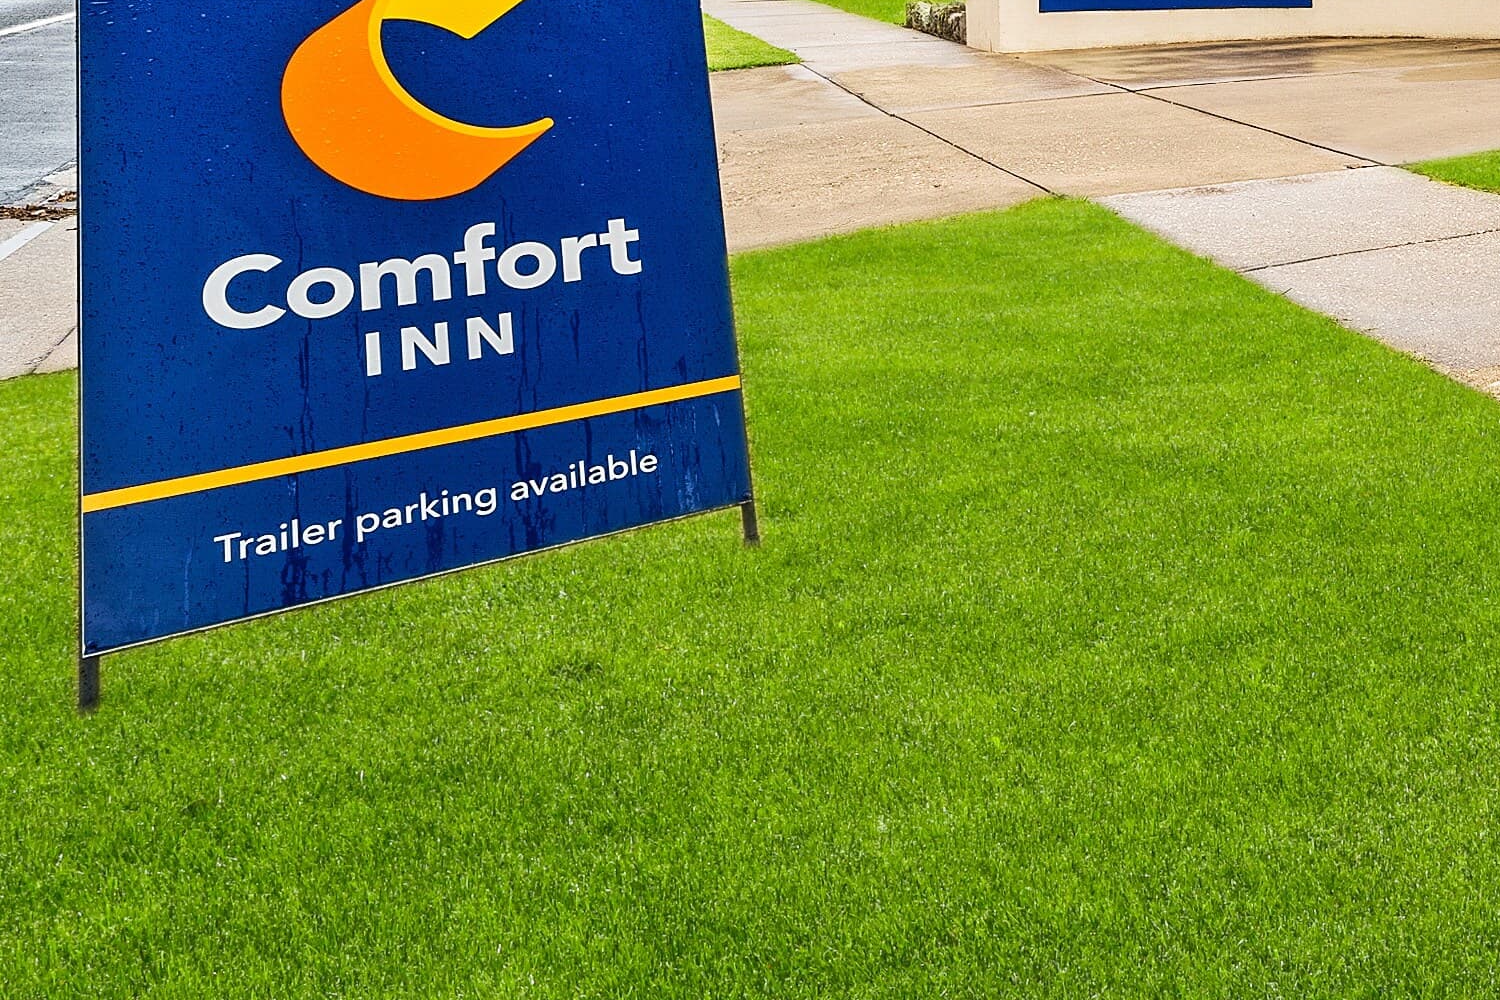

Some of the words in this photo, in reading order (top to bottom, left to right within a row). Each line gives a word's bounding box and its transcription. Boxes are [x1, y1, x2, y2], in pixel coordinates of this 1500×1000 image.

[201, 217, 643, 331] Comfort
[364, 310, 515, 377] INN
[212, 515, 342, 565] Trailer
[355, 480, 499, 544] parking
[508, 446, 659, 502] available
